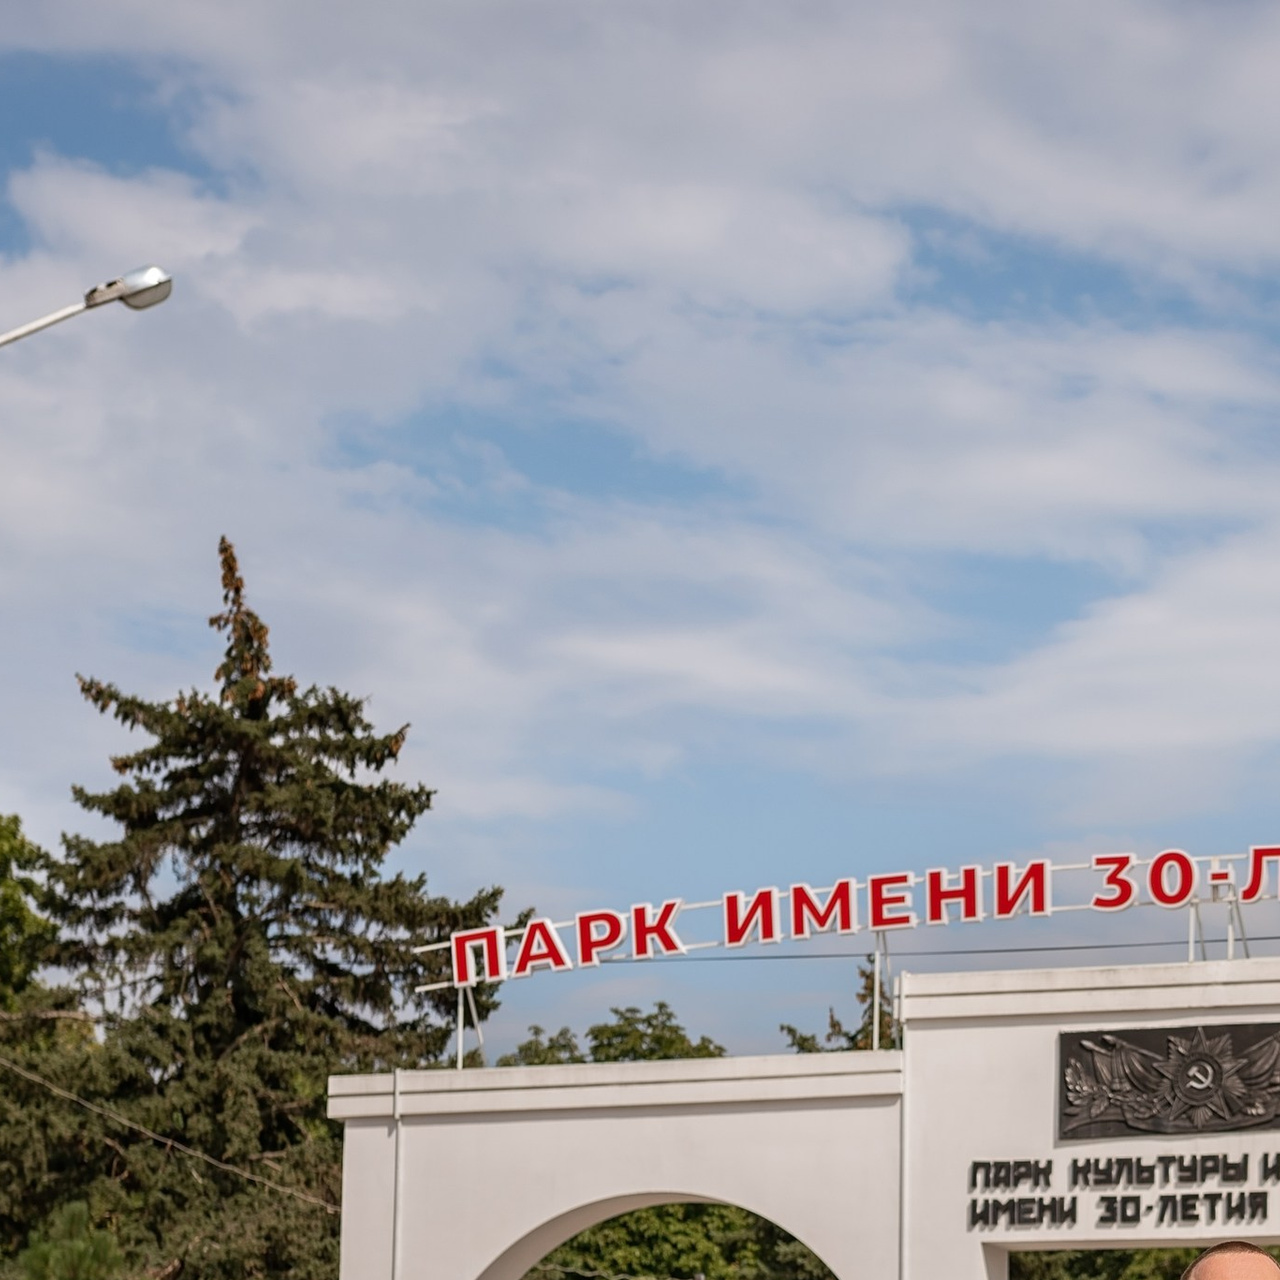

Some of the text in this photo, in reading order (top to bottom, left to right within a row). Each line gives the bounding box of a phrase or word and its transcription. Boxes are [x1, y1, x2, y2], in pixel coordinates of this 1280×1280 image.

[451, 899, 680, 986] ПАРК
[723, 859, 1048, 946] ИМЕНИ
[970, 1159, 1052, 1190] ПАРК
[1071, 1153, 1249, 1188] КУЛЬТУРЫ
[970, 1196, 1077, 1228] ИМЕНИ
[1098, 1191, 1269, 1224] 30-ЛЕТИЯ
